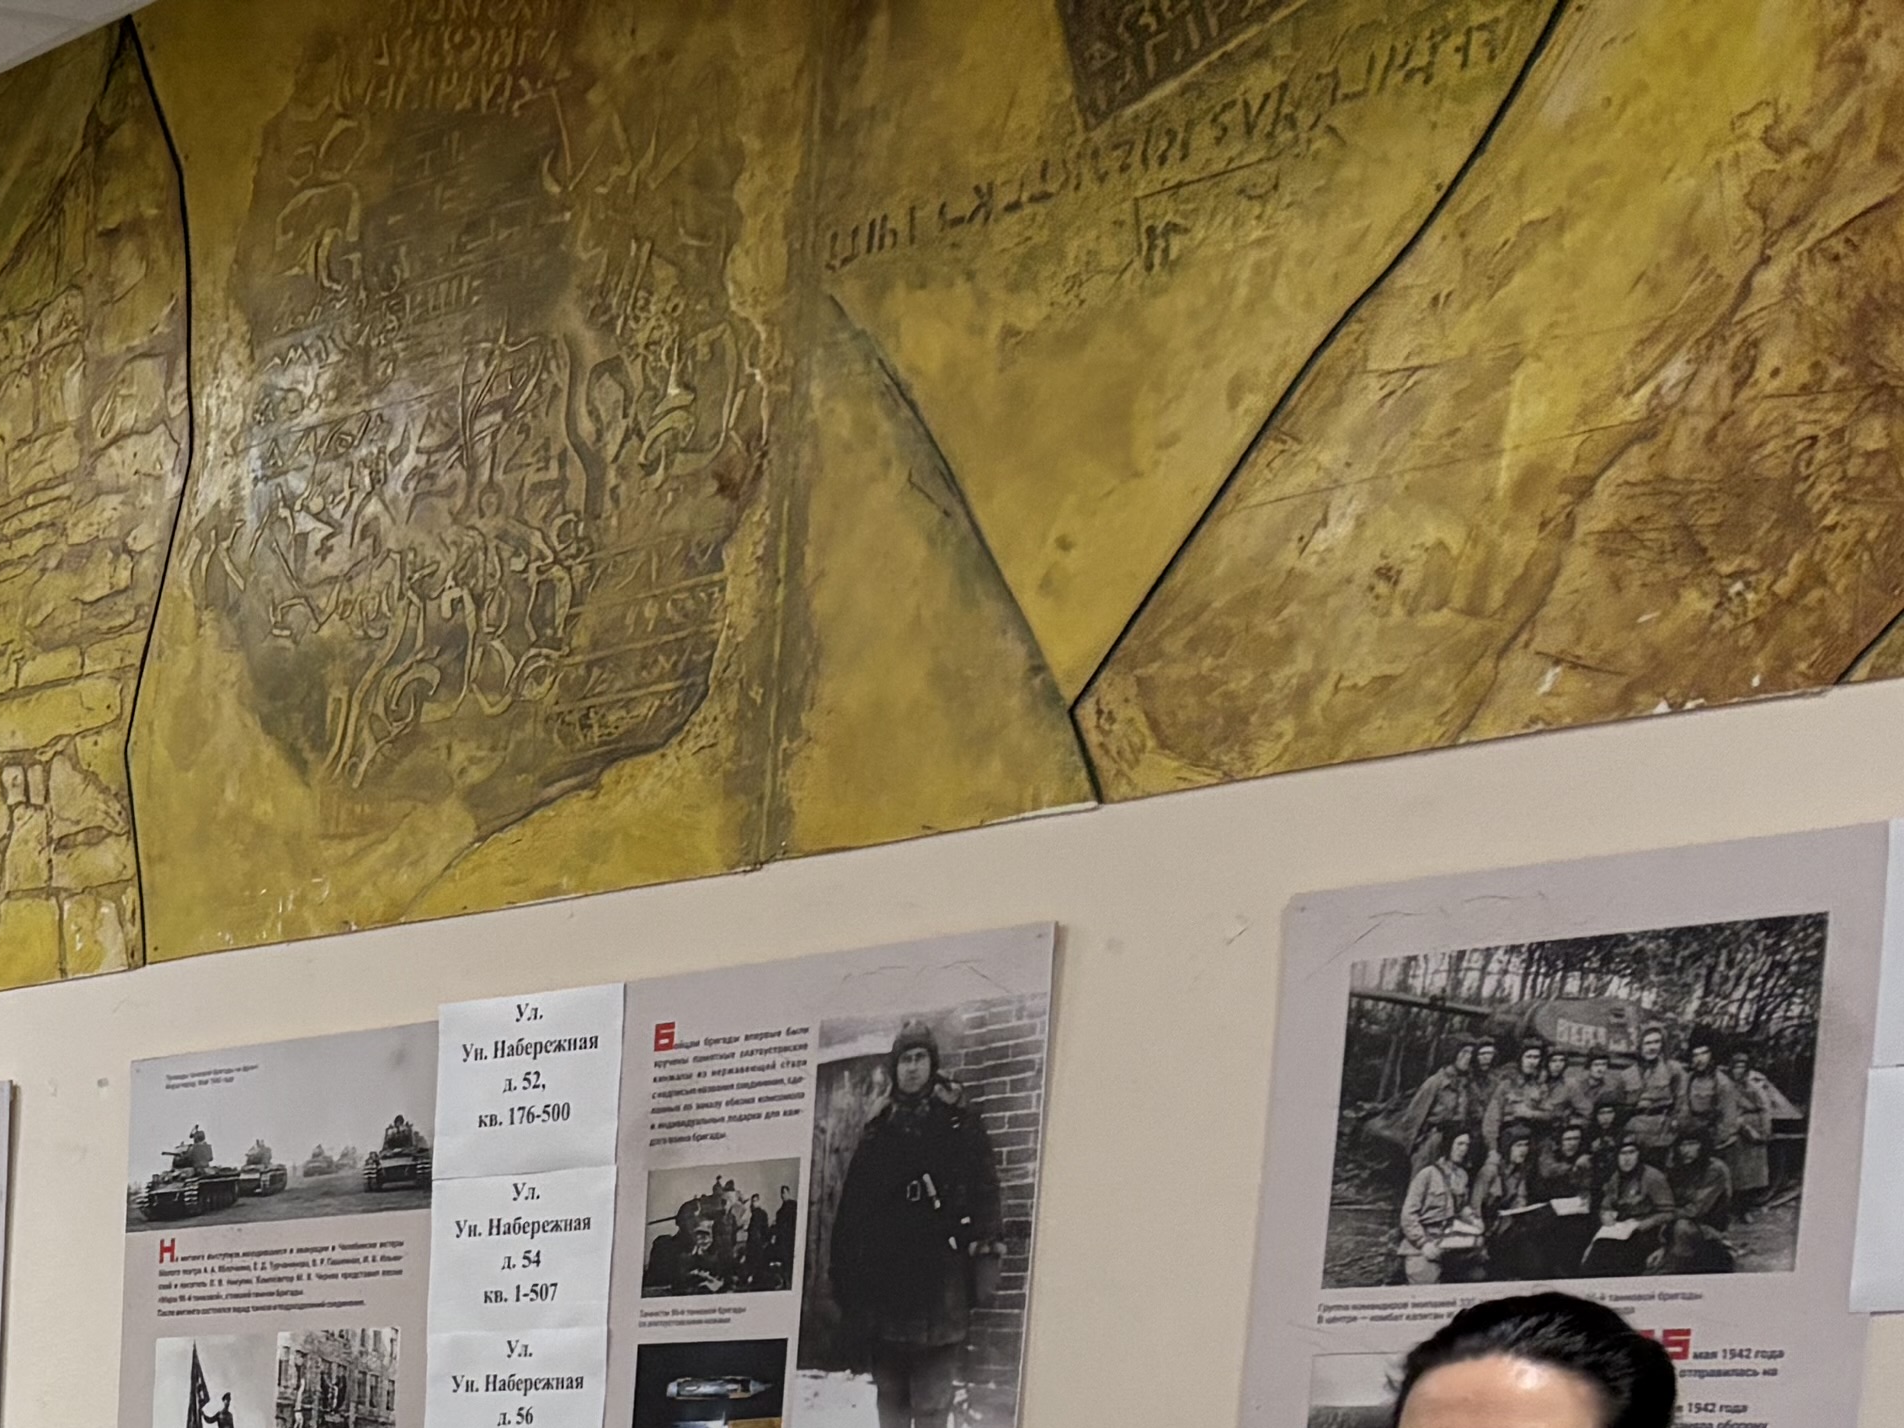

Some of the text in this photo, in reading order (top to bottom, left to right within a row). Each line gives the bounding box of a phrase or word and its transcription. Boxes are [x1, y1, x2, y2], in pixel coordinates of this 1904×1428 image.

[516, 1003, 543, 1022] Ул.
[462, 1035, 599, 1062] Ун. Набережная
[502, 1071, 545, 1094] д. 52,
[478, 1102, 570, 1128] кв. 176-500
[512, 1182, 540, 1201] Ул.
[455, 1216, 591, 1239] Ун. Набережная
[501, 1250, 541, 1270] д. 54
[483, 1282, 558, 1303] кв. 1-507
[507, 1340, 533, 1358] Ул.
[1693, 1351, 1717, 1359] мая
[1722, 1349, 1752, 1359] 1942
[1754, 1350, 1784, 1360] года
[452, 1374, 584, 1396] Ун. Набережная
[497, 1406, 534, 1426] д. 56
[1688, 1403, 1747, 1413] 1942 года
